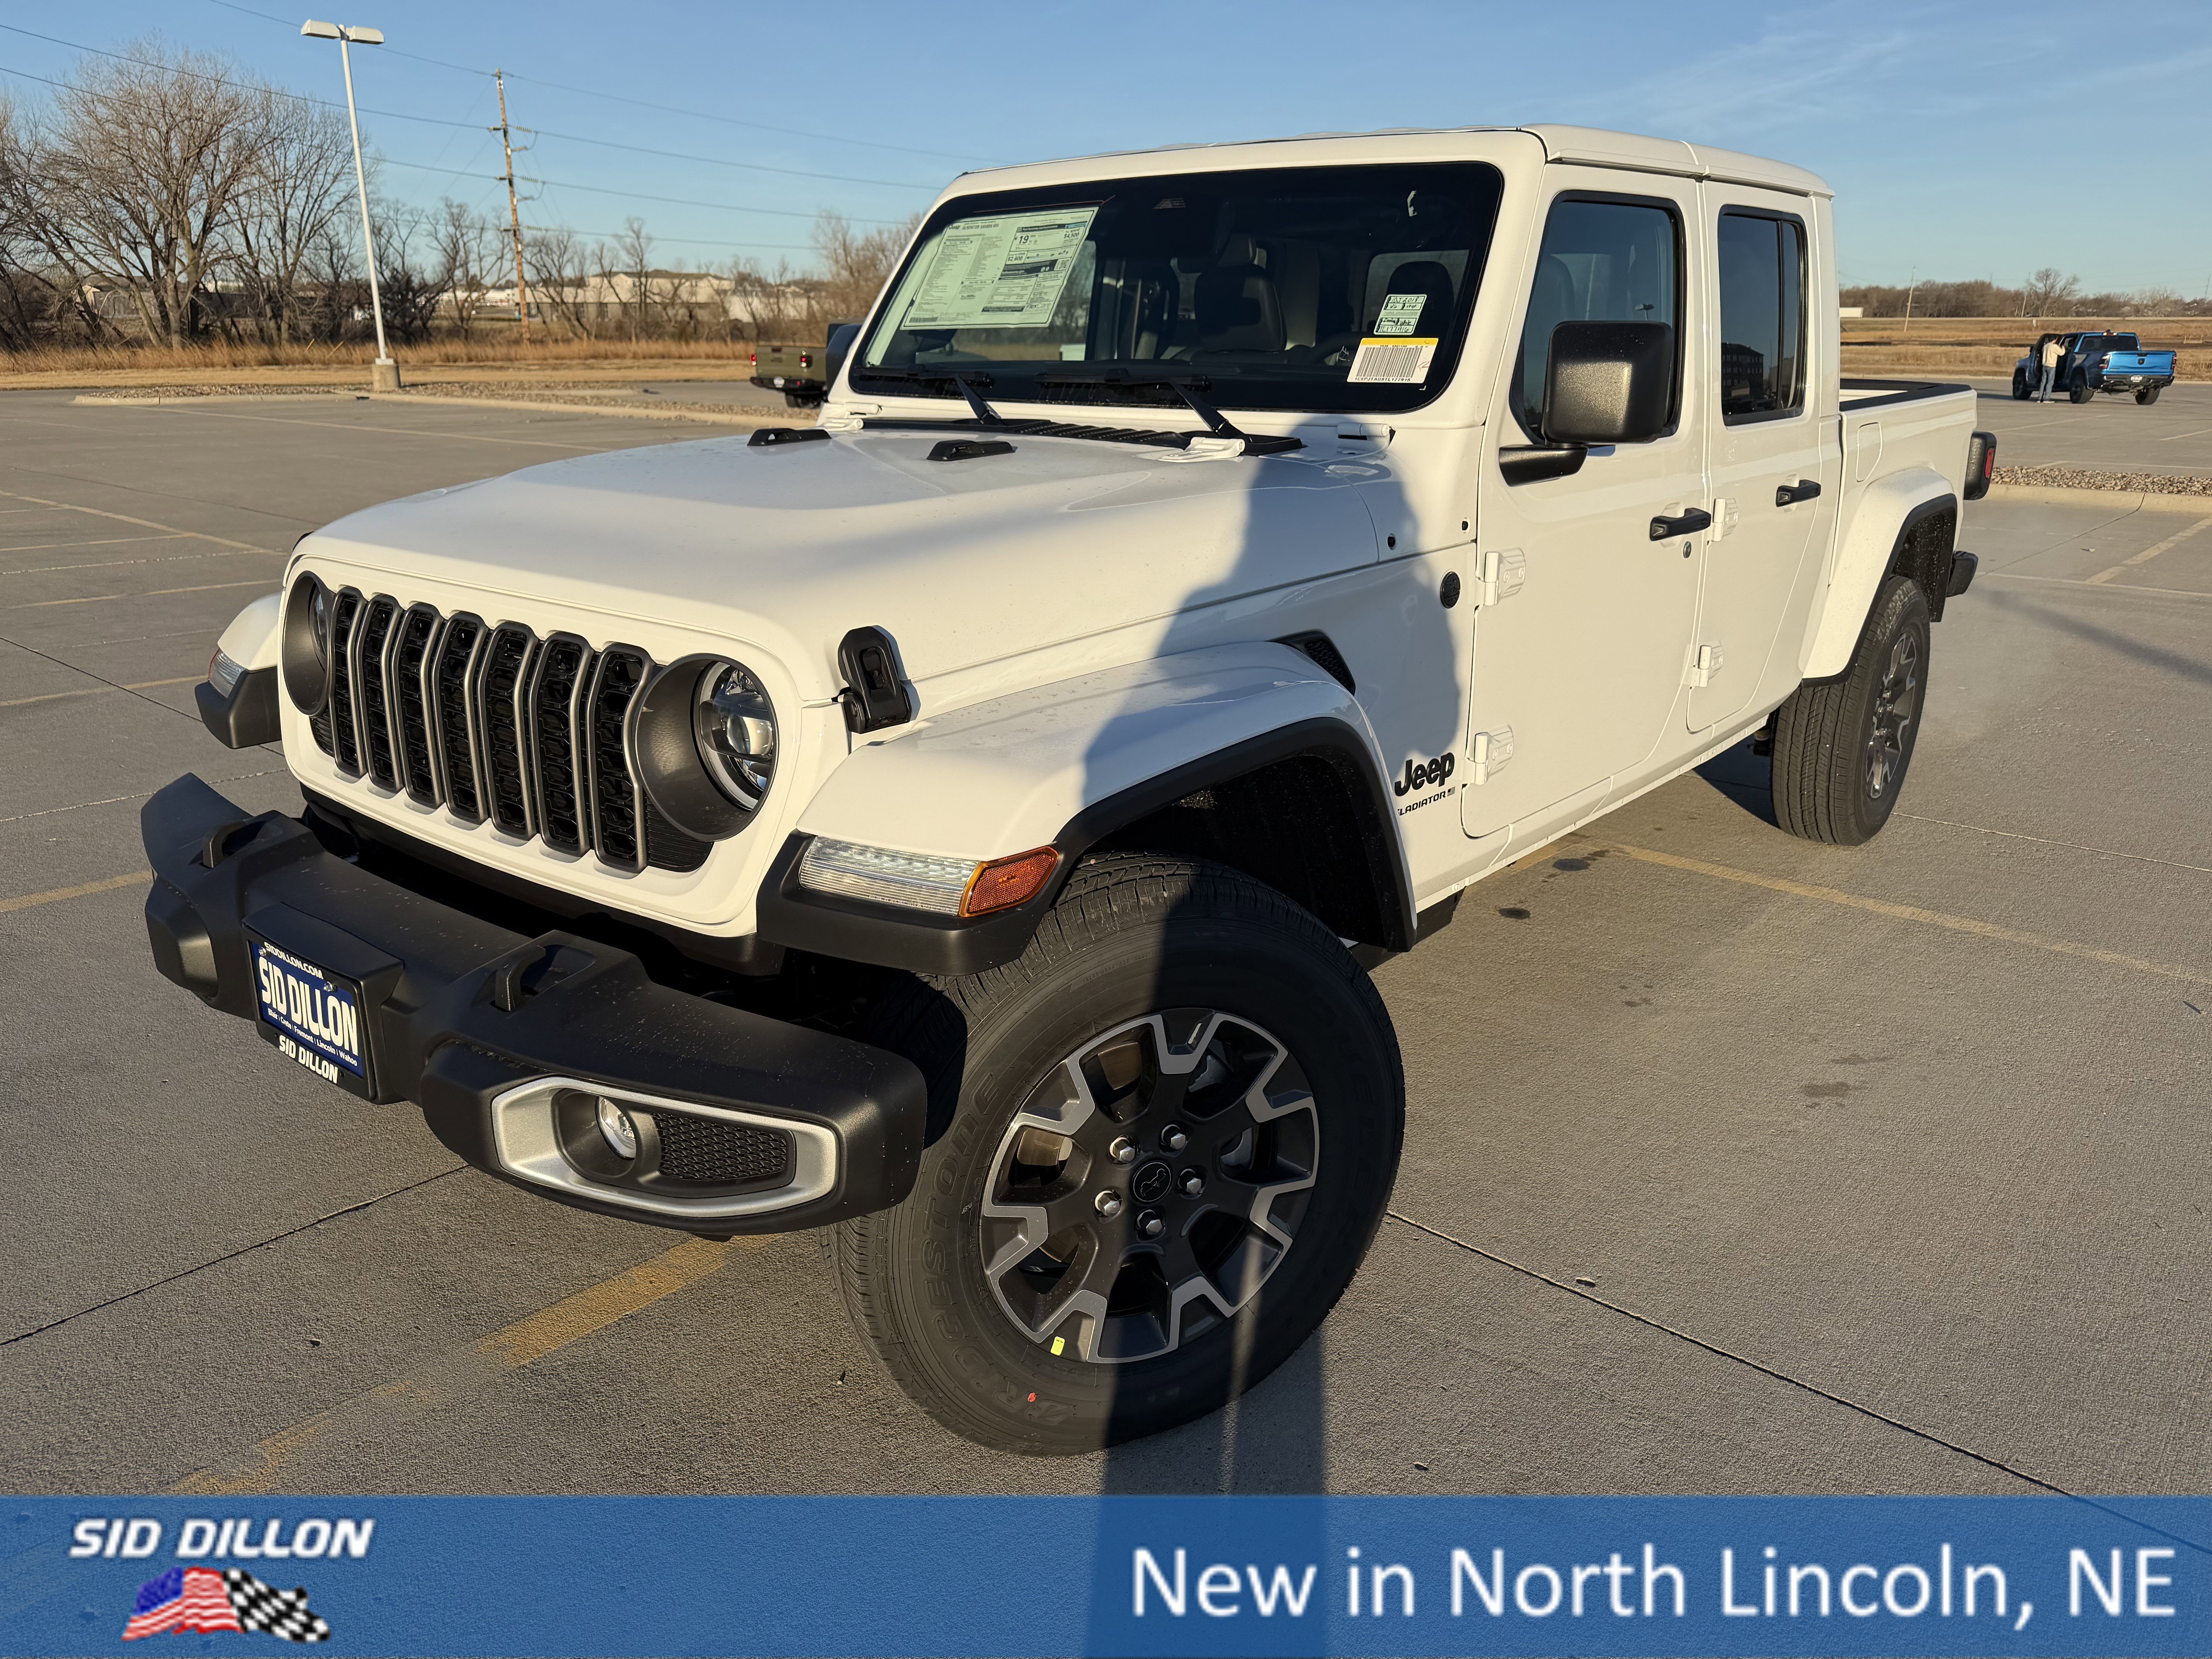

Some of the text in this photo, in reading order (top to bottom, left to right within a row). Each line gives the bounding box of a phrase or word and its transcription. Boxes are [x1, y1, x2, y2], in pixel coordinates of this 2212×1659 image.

[1019, 235, 1029, 244] 19
[1395, 752, 1455, 797] Jeep
[264, 942, 324, 980] SIDDILLON.COM
[259, 957, 358, 1056] SID DILLON
[280, 1035, 338, 1084] SID DILLON
[294, 1025, 314, 1043] Fremont
[316, 1039, 336, 1054] Lincoln
[920, 1070, 1070, 1426] BRIDGESTONE
